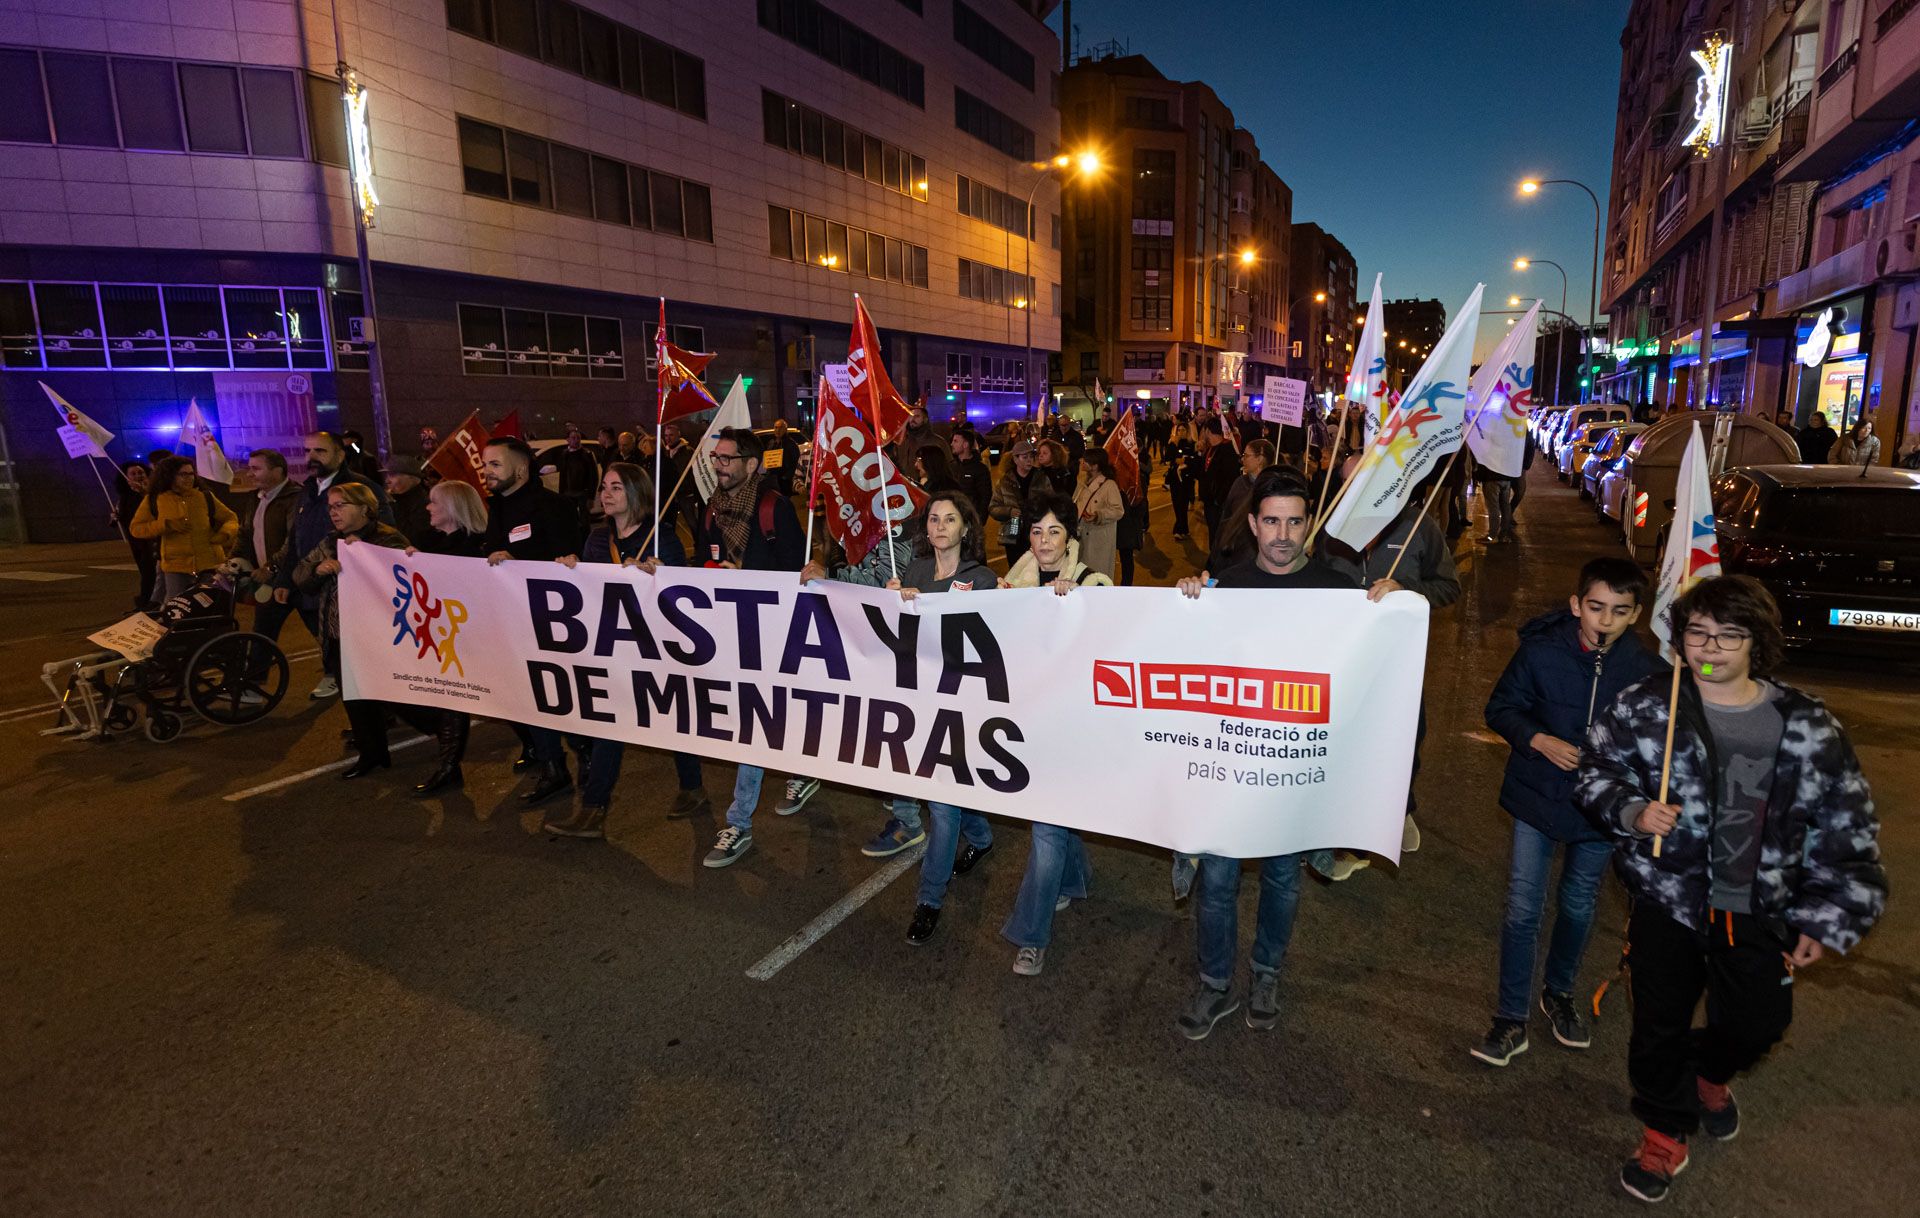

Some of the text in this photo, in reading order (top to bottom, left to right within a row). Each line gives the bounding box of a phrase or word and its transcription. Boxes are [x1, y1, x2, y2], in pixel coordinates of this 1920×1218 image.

[1842, 612, 1885, 626] 7988
[526, 578, 1010, 703] BASTA YA
[393, 673, 423, 682] Sindicato
[434, 678, 466, 689] Empleados
[467, 682, 491, 694] Públicos
[408, 683, 480, 700] Comunidad Valenciana
[1149, 673, 1264, 708] CCOO
[526, 660, 1030, 793] DE MENTIRAS
[1220, 719, 1329, 741] federació de
[1144, 731, 1327, 759] serveis a la ciutadania
[1187, 761, 1326, 787] país valencià
